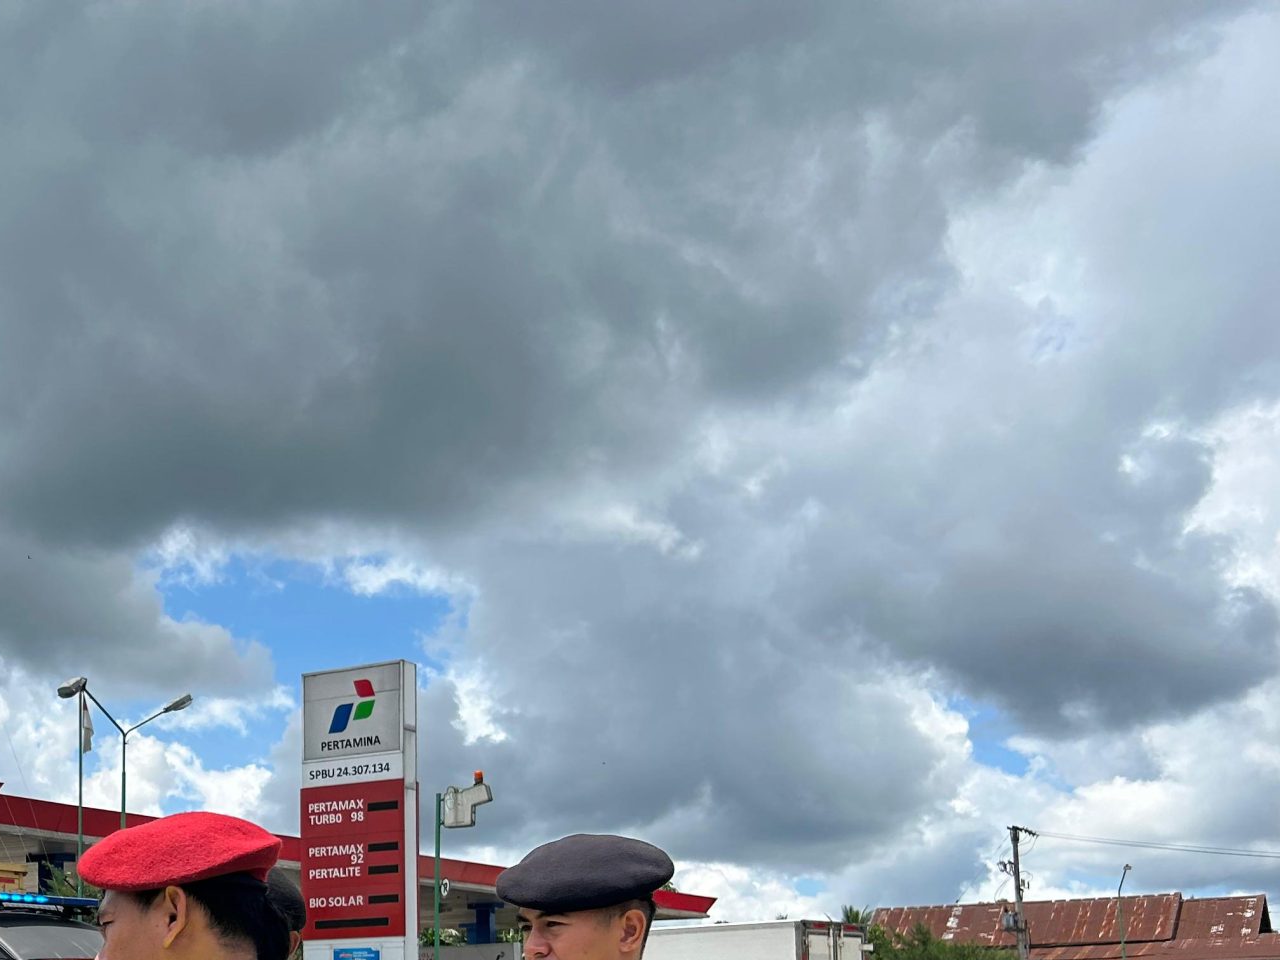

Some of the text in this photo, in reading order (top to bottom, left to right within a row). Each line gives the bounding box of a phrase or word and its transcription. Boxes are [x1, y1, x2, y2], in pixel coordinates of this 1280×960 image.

[321, 735, 381, 751] PERTAMINA
[309, 762, 390, 780] SPBU 24.307.134
[308, 799, 364, 813] PERTAMAX
[350, 811, 364, 822] 98
[308, 843, 364, 858] PERTAMAX
[350, 853, 364, 864] 92
[309, 866, 361, 880] PERTALITE
[309, 895, 364, 909] BIO SOLAR
